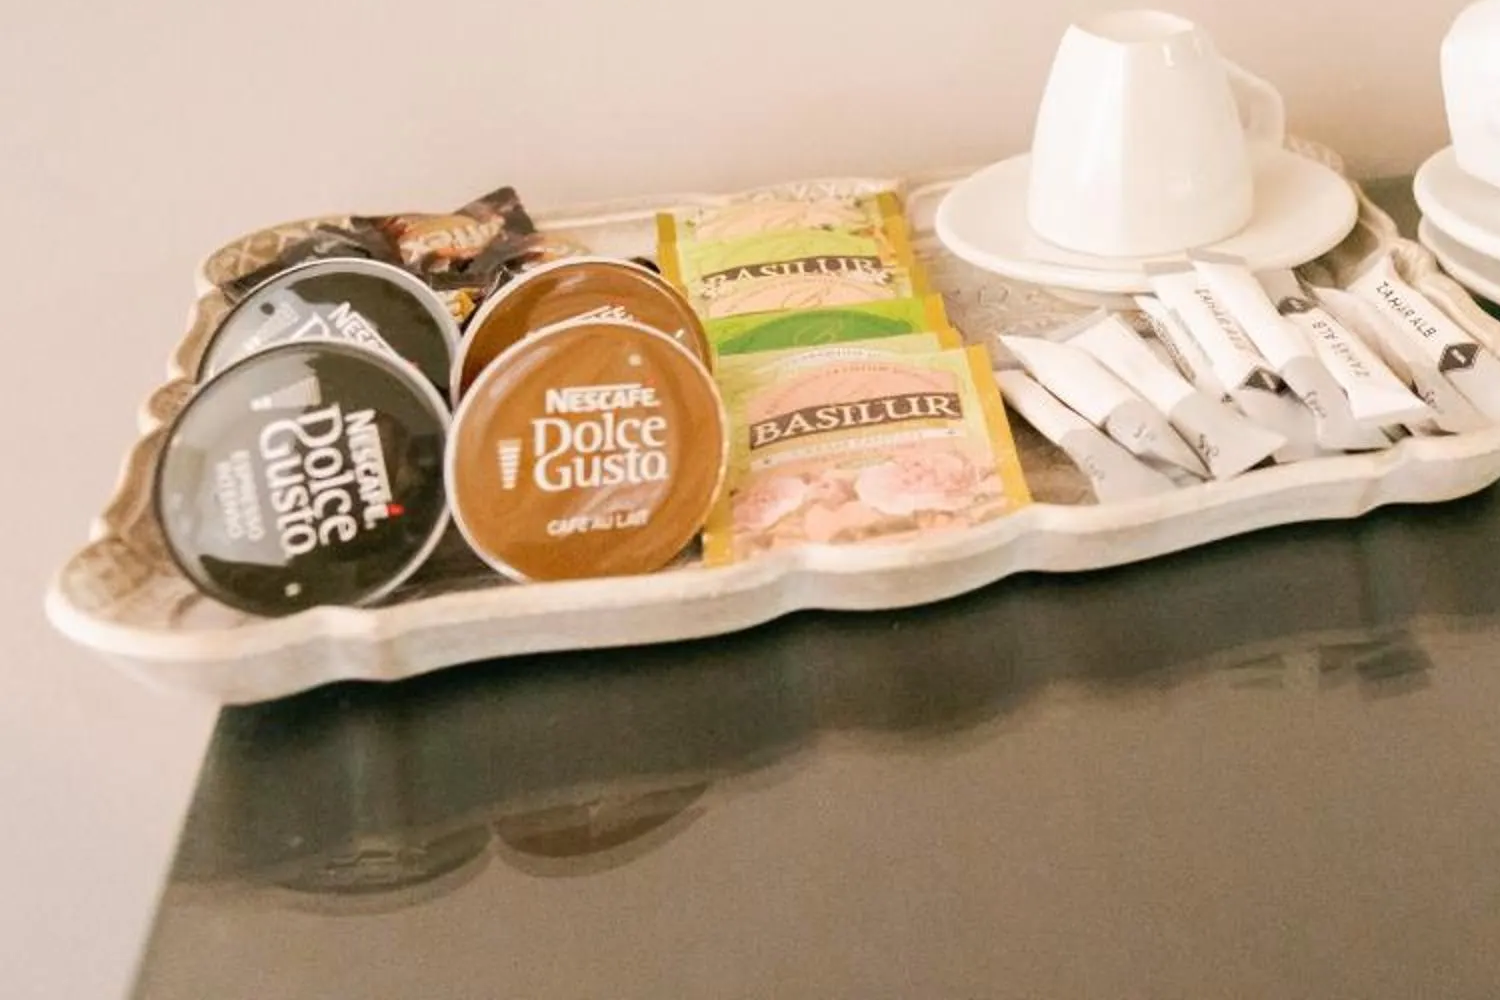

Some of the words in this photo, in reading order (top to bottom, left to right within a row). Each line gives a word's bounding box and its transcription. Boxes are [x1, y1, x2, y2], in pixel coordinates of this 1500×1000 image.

[532, 412, 668, 457] Dolce
[754, 395, 960, 447] BASILUR
[258, 418, 318, 557] Gusto
[297, 404, 358, 546] Dolce
[533, 448, 670, 492] Gusto
